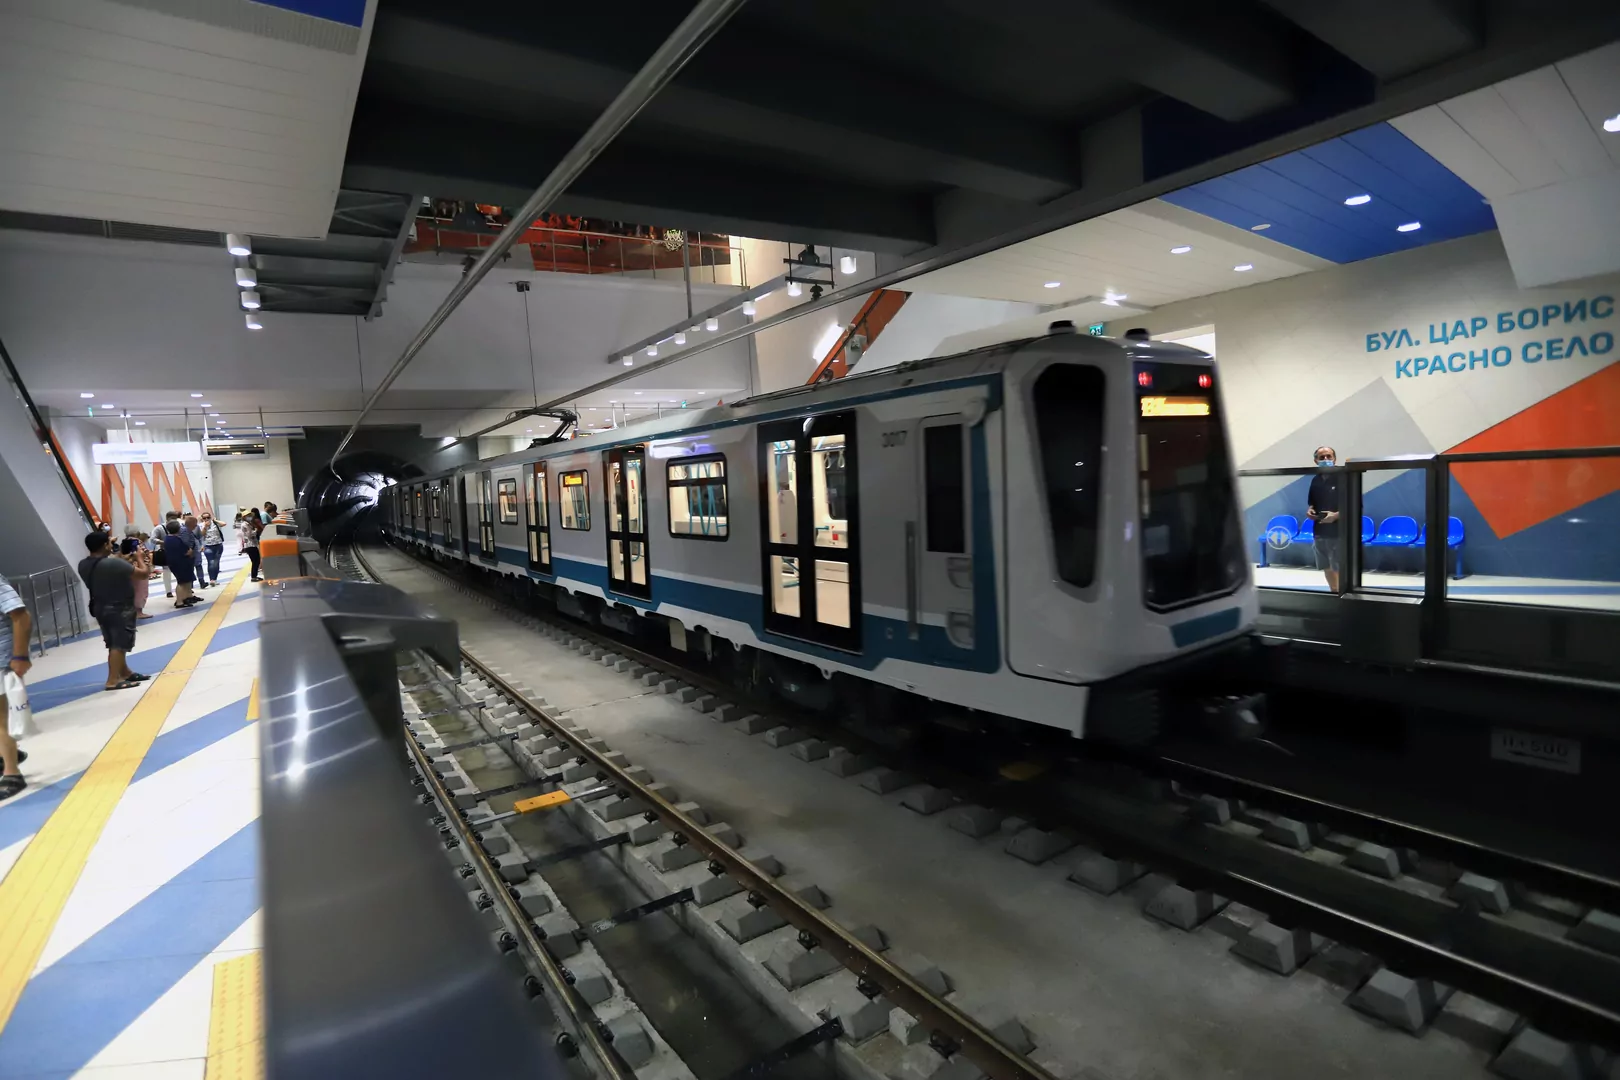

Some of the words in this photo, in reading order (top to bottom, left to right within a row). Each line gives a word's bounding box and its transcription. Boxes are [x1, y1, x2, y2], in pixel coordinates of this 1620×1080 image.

[1366, 328, 1420, 353] БУЛ.
[1429, 317, 1488, 345] ЦАР
[1497, 295, 1615, 333] БОРИС
[1395, 346, 1512, 379] КРАСНО
[1521, 332, 1614, 363] СЕЛО
